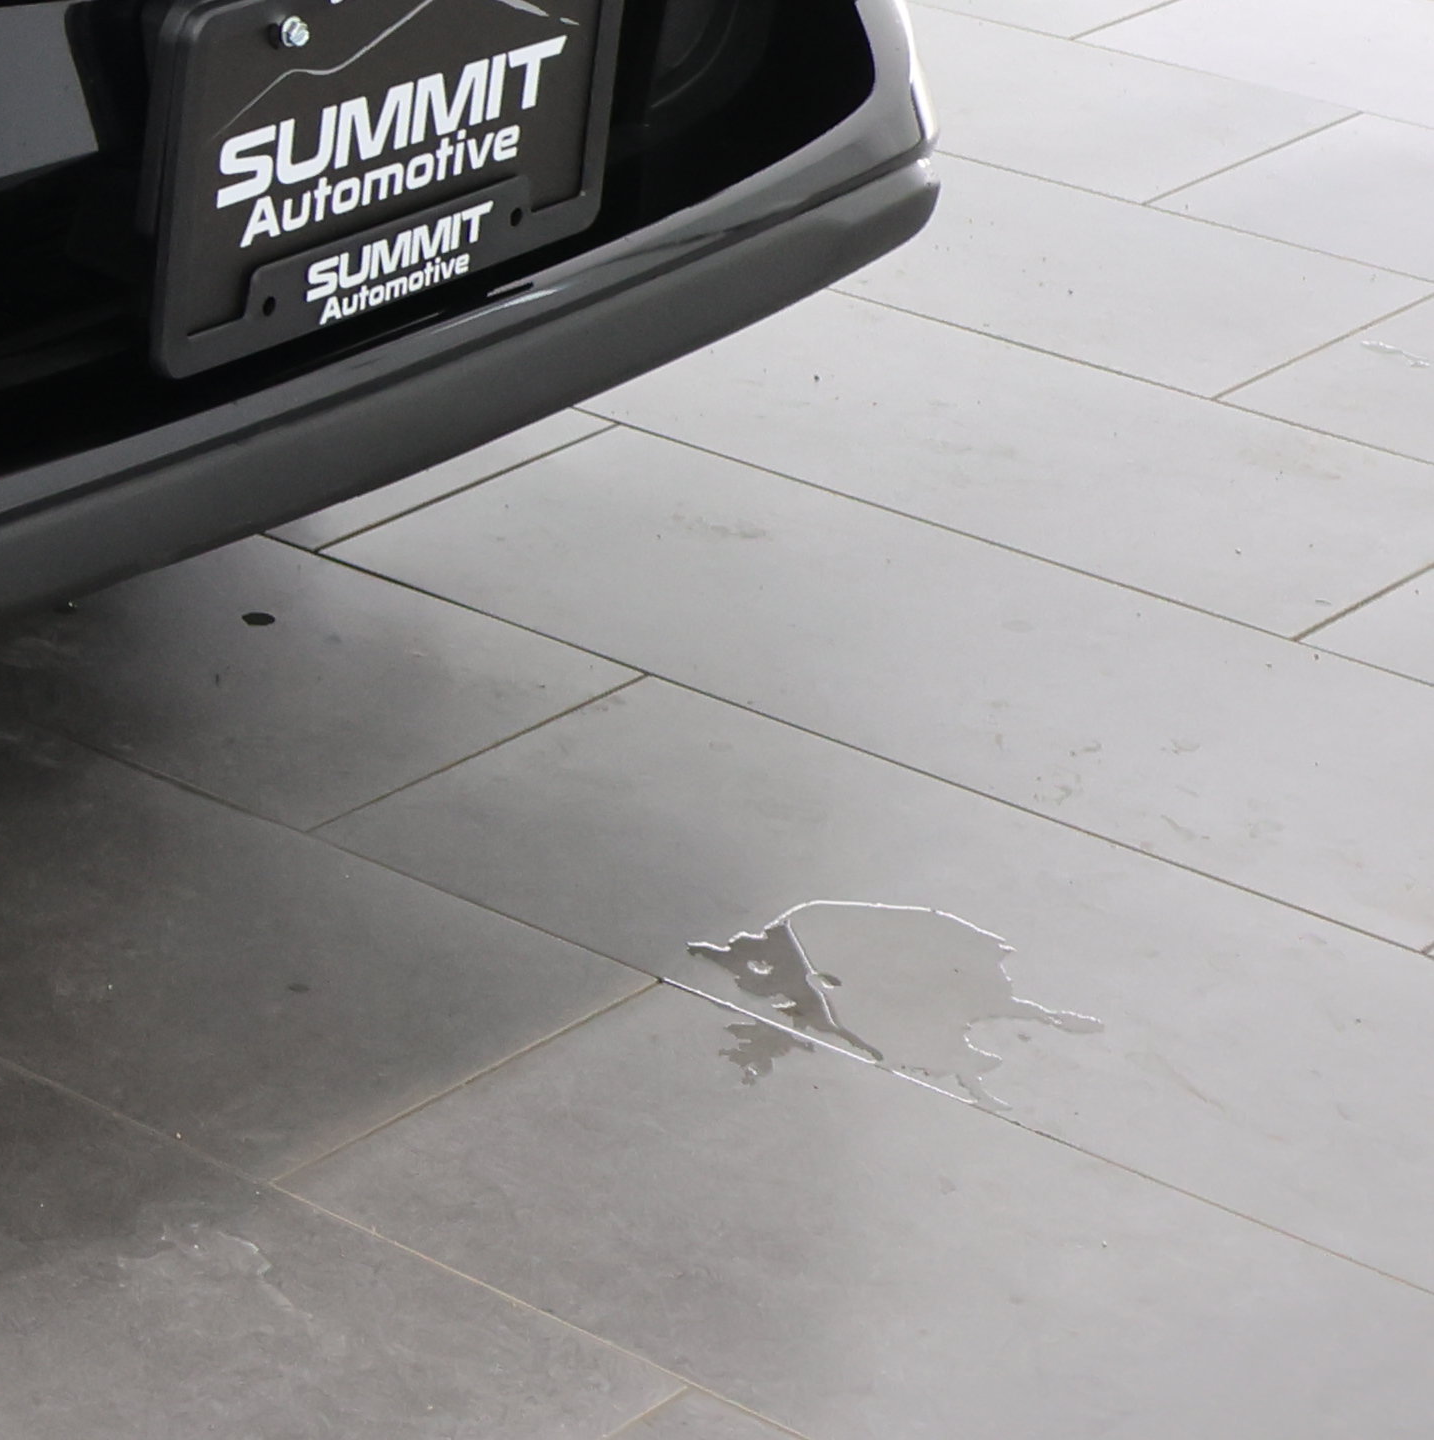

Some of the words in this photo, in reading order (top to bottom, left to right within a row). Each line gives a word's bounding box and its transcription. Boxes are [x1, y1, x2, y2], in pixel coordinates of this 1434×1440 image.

[216, 35, 568, 209] SUMMIT
[240, 123, 521, 249] Automotive
[305, 200, 495, 303] SUMMIT
[318, 252, 471, 326] Automotive
